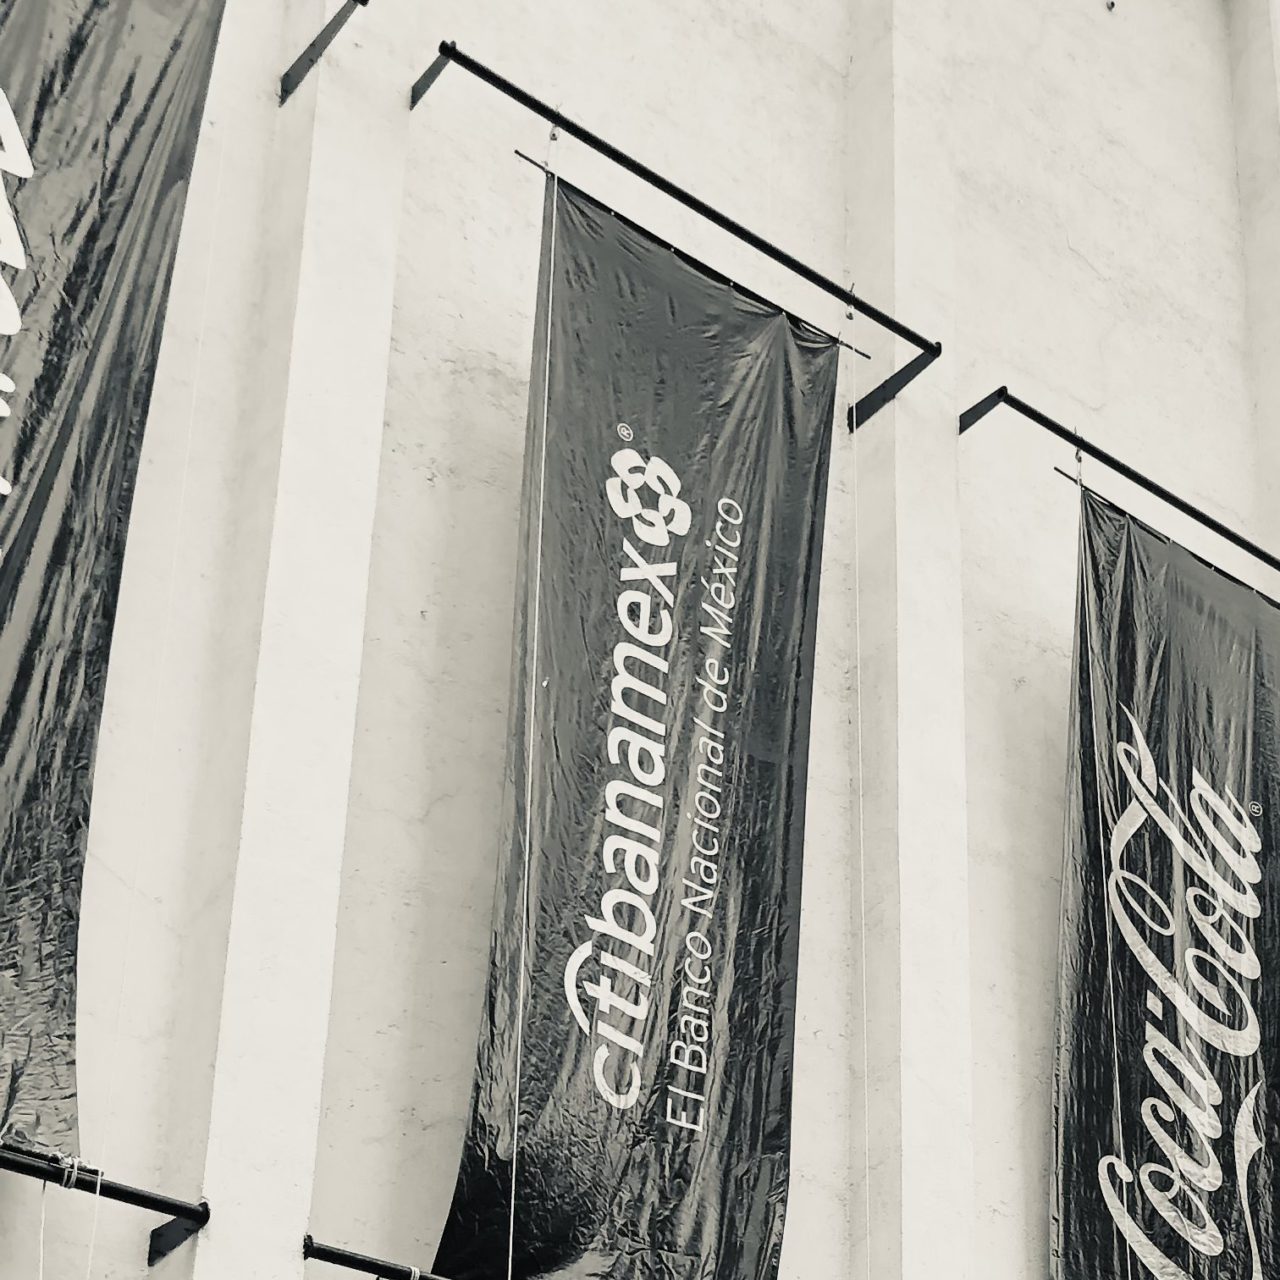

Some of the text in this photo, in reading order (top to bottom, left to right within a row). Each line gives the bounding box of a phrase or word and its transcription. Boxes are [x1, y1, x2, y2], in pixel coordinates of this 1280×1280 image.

[665, 497, 744, 1133] El Banco Nacional de México
